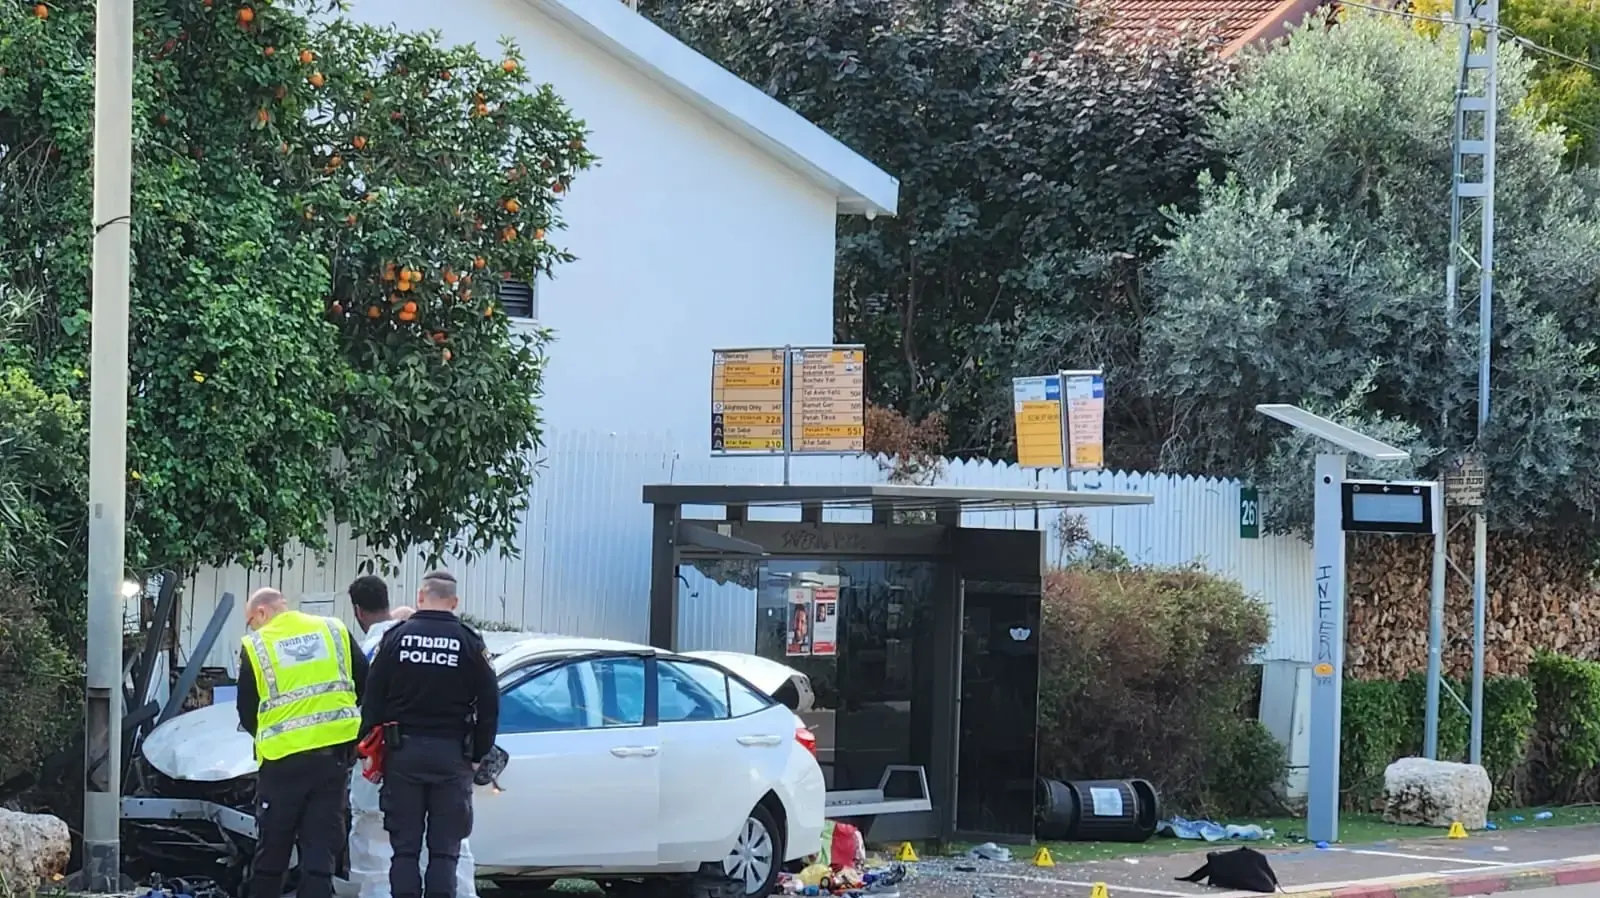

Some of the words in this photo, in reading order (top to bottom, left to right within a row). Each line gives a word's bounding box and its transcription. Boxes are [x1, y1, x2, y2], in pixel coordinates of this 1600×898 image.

[765, 415, 781, 423] 228
[847, 427, 862, 436] 551
[765, 440, 781, 448] 210
[401, 634, 460, 651] משטרה
[400, 650, 459, 667] POLICE
[1097, 886, 1103, 896] 7
